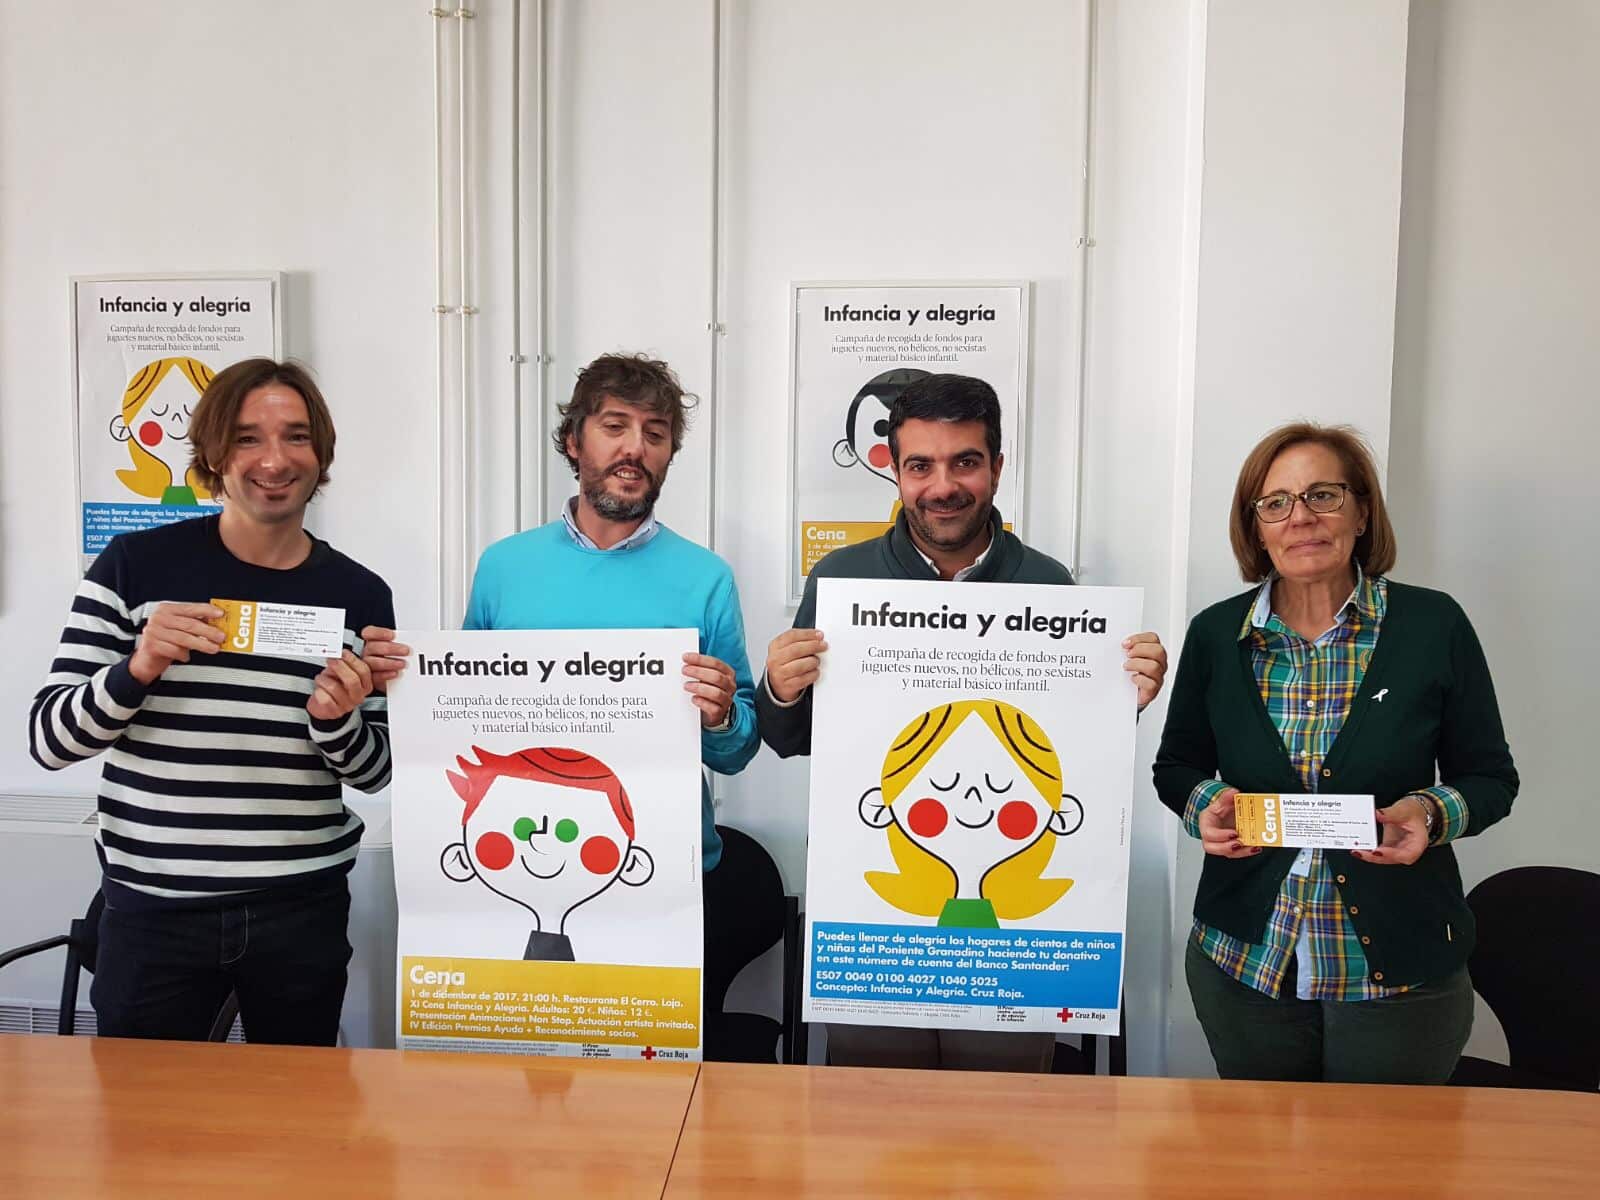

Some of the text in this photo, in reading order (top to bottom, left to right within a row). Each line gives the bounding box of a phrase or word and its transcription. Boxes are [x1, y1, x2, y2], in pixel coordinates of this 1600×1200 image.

[100, 296, 251, 317] Infancia y alegría
[824, 304, 995, 326] Infancia y alegría
[807, 527, 846, 540] Cena
[232, 605, 252, 649] Cena
[852, 602, 1107, 639] Infancia y alegría
[868, 647, 1086, 665] Campaña de recogida de fondos para
[419, 652, 664, 683] Infancia y alegría
[861, 660, 1092, 679] juguetes nuevos, no bélicos, no sexistas
[902, 676, 1050, 692] y material básico infantil.
[437, 694, 647, 707] Campaña de recogida de fondos para
[432, 709, 654, 721] juguetes nuevos, no bélicos, no sexistas
[472, 722, 615, 736] y material básico infantil.
[1262, 799, 1278, 844] Cena
[817, 931, 855, 941] Puedes
[859, 932, 890, 943] llenar
[892, 933, 905, 943] de
[950, 934, 964, 945] los
[968, 936, 1011, 950] hogares
[1014, 937, 1028, 947] de
[1031, 938, 1068, 949] cientos
[1071, 939, 1084, 949] de
[1087, 940, 1116, 950] niños
[817, 943, 1100, 961] y niñas del Poniente Granadino haciendo tu donativo
[833, 956, 854, 964] este
[857, 956, 898, 965] número
[902, 957, 915, 966] de
[918, 959, 953, 967] cuenta
[956, 960, 973, 969] del
[976, 960, 1008, 969] Banco
[1011, 961, 1070, 971] Santander:
[410, 965, 465, 986] Cena
[816, 971, 998, 986] ES07 0049 0100 4027 1040 5025
[412, 989, 415, 997] 1
[419, 989, 430, 998] de
[433, 989, 476, 1000] diciembre
[479, 992, 491, 1000] de
[522, 993, 549, 1002] 21:00
[552, 994, 560, 1003] h.
[563, 994, 619, 1005] Restaurante
[621, 996, 629, 1005] El
[631, 998, 658, 1007] Cerro.
[662, 998, 684, 1009] Loja.
[816, 982, 868, 993] Concepto:
[871, 983, 913, 995] Infancia
[916, 987, 923, 996] y
[971, 988, 995, 998] Cruz
[998, 989, 1025, 1000] Roja.
[410, 1000, 420, 1008] XI
[423, 1001, 444, 1009] Cena
[448, 1002, 483, 1011] Infancia
[532, 1004, 570, 1014] Adultos:
[573, 1006, 584, 1014] 20
[598, 1007, 627, 1016] Niños:
[631, 1008, 642, 1016] 12
[1091, 1013, 1106, 1021] Roja
[410, 1021, 419, 1029] IV
[455, 1024, 491, 1032] Premios
[494, 1025, 524, 1034] Ayuda
[535, 1026, 606, 1037] Reconocimiento
[609, 1030, 639, 1038] socios.
[469, 1013, 526, 1023] Animaciones
[529, 1015, 548, 1024] Non
[551, 1016, 574, 1025] Stop.
[624, 1019, 653, 1028] artista
[656, 1020, 696, 1030] invitado.
[658, 1050, 688, 1059] Cruz Roja
